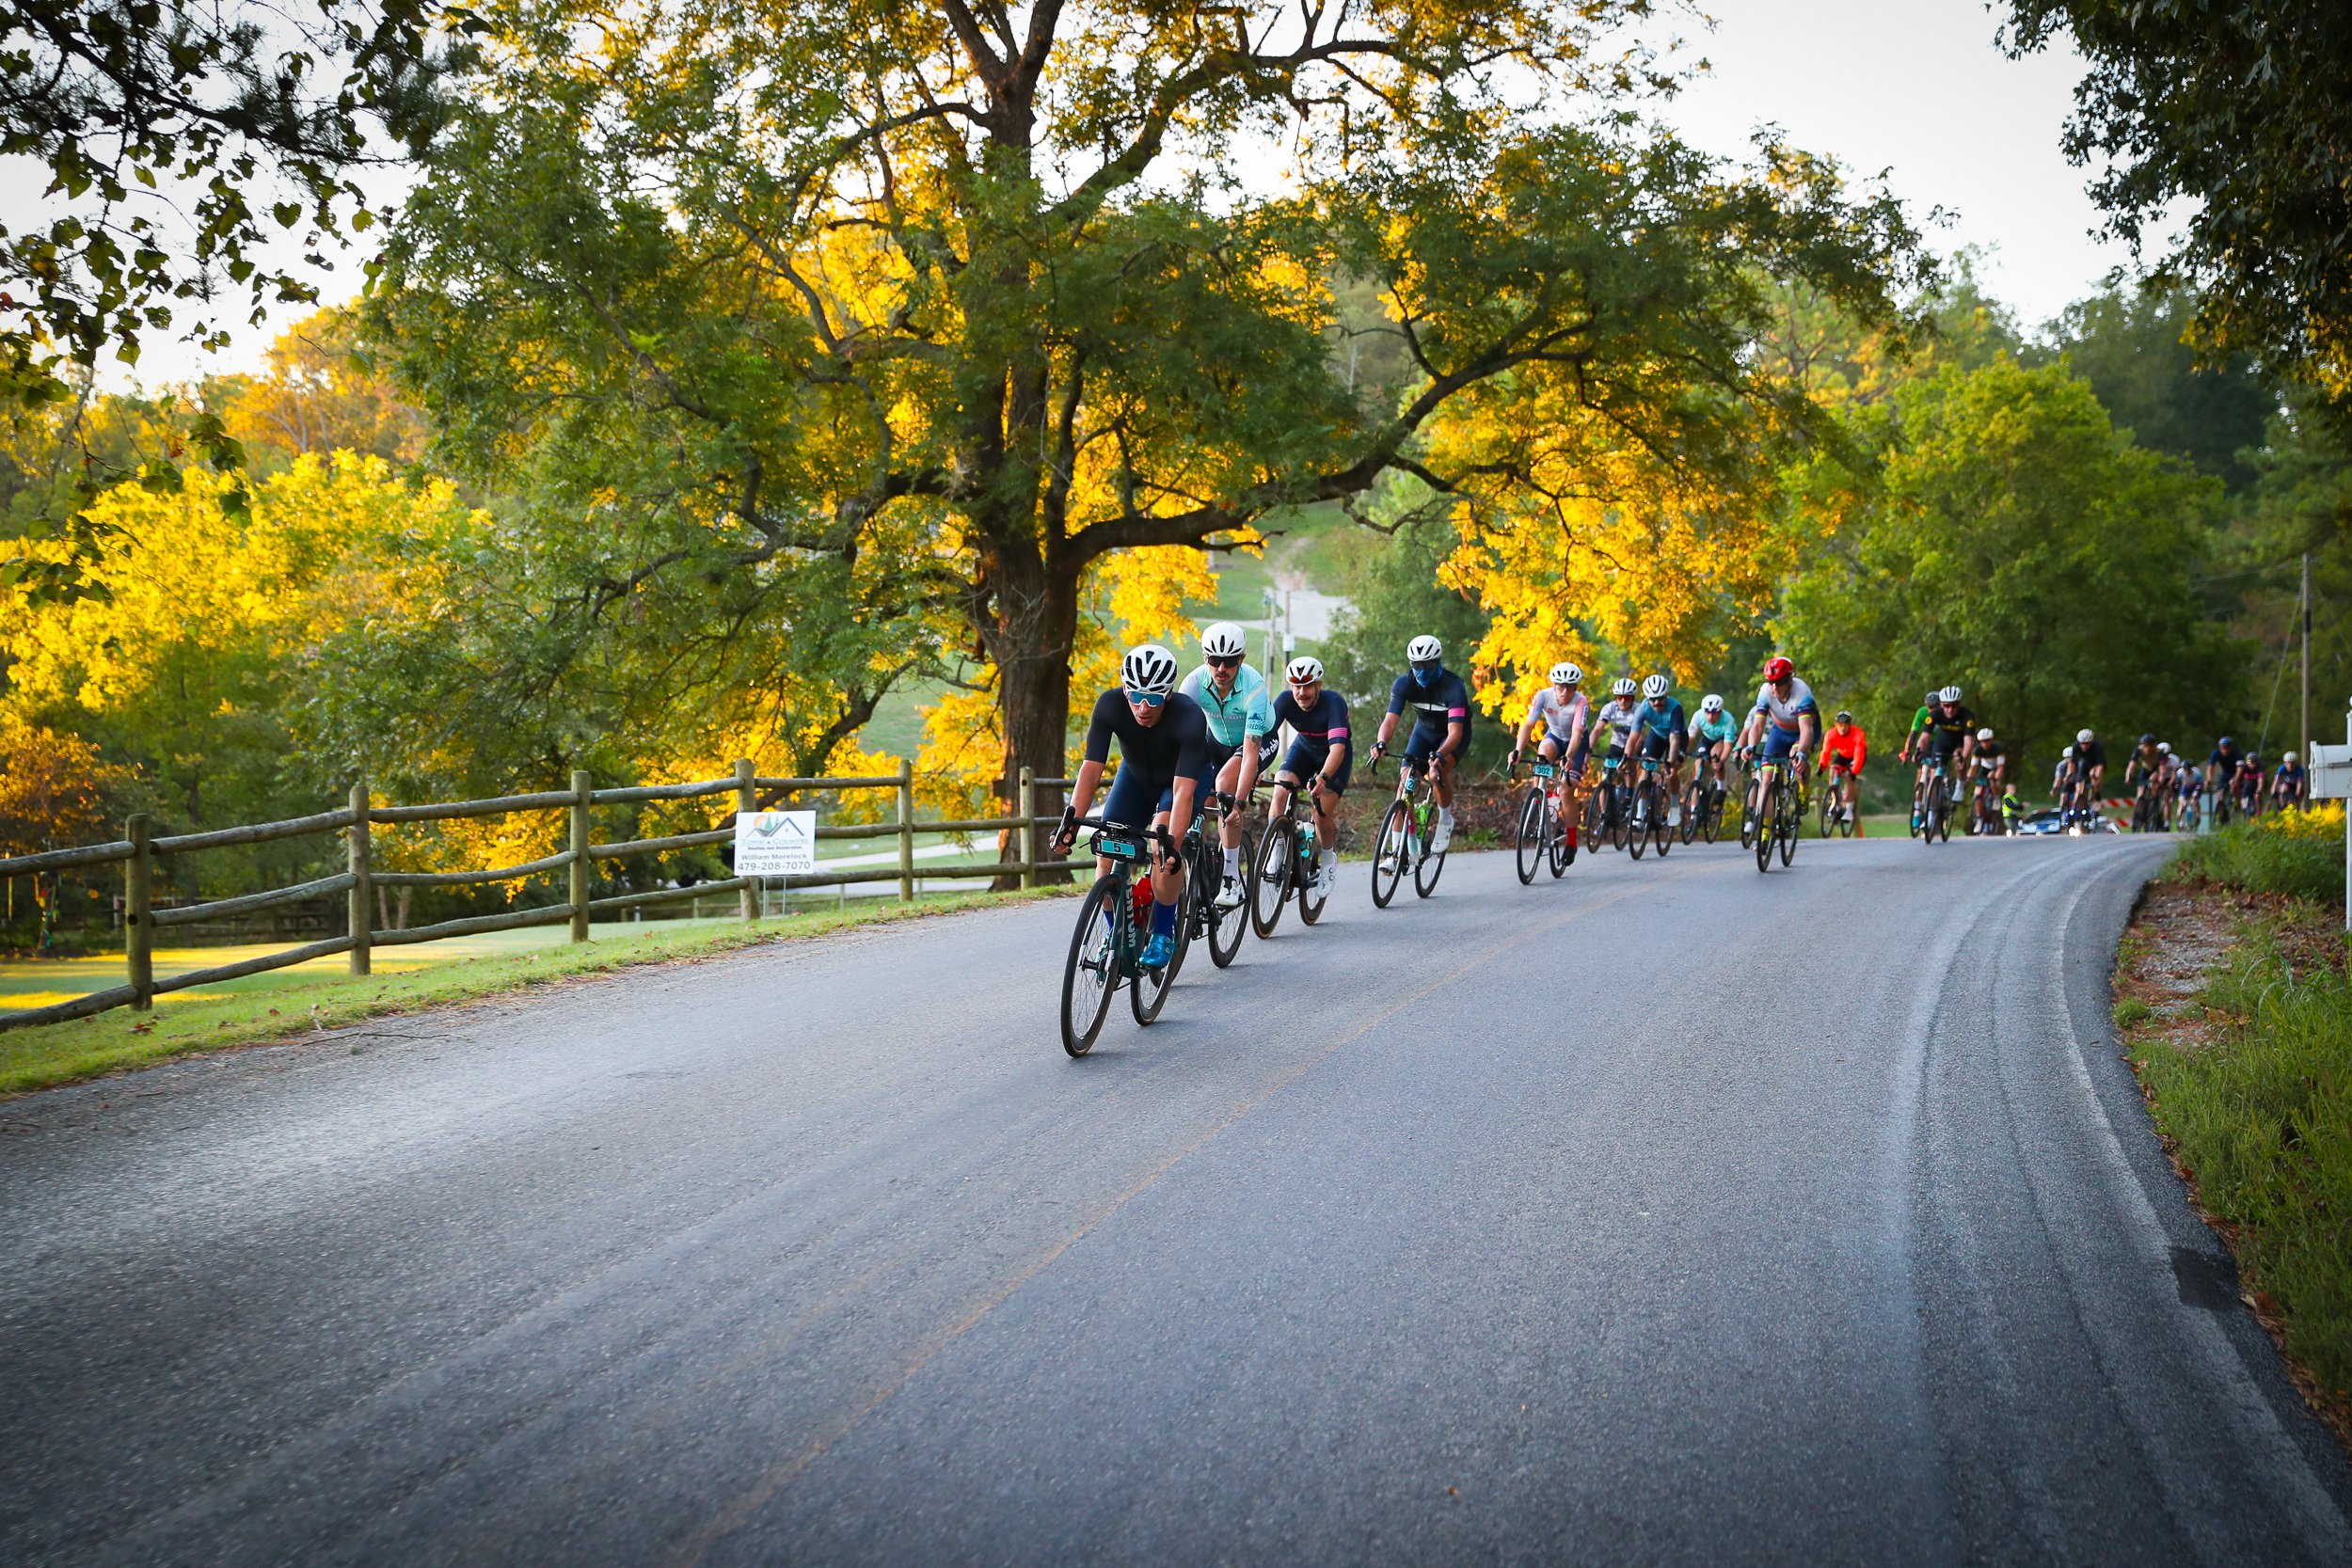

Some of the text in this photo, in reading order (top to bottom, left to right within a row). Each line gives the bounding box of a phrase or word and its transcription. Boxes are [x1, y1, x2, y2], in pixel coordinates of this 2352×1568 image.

[1536, 767, 1550, 775] 302
[1114, 843, 1121, 852] 5
[738, 861, 810, 870] 479-208-7070
